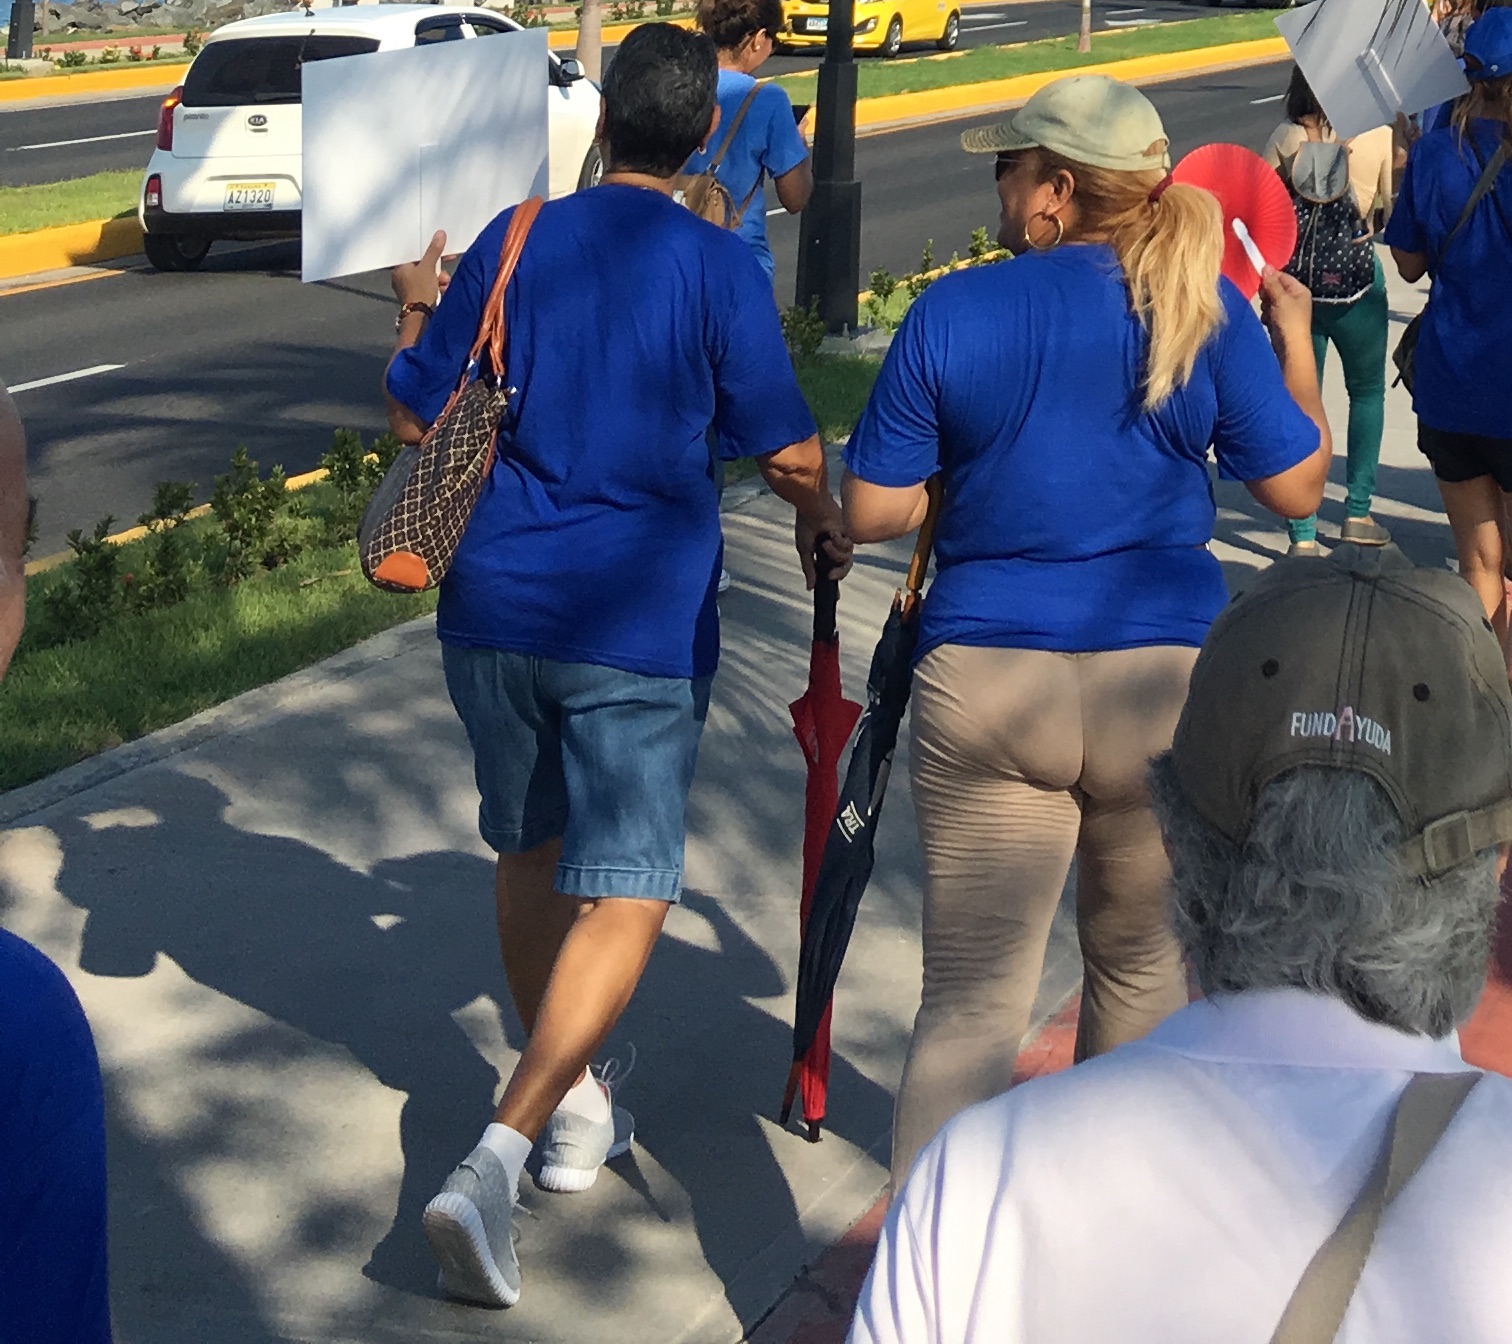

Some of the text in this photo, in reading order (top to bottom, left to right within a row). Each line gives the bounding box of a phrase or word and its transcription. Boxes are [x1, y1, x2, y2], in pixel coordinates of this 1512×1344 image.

[227, 189, 271, 204] AZ1320
[1290, 706, 1391, 756] FUNDAYUDA
[841, 805, 860, 834] TRA
